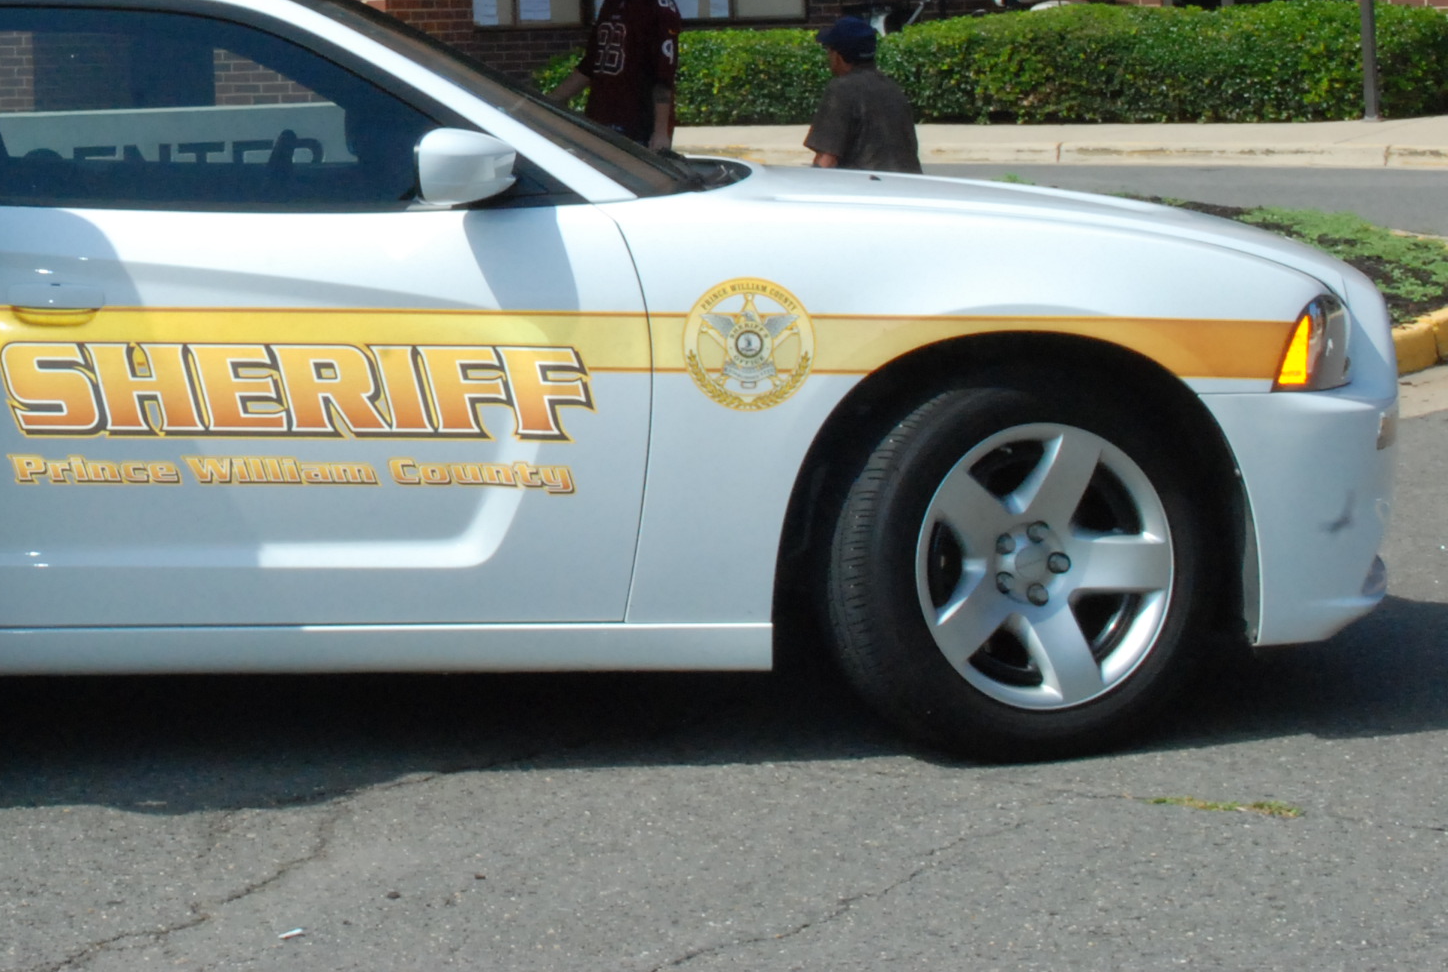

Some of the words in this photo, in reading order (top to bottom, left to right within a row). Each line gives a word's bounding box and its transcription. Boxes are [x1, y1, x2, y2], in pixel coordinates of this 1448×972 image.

[700, 288, 729, 310] PRINCE
[730, 283, 767, 293] WILLIAM
[769, 288, 798, 311] COUNTY
[0, 341, 598, 442] SHERIFF
[7, 454, 182, 485] Prince
[181, 455, 381, 486] William
[387, 457, 576, 494] County
